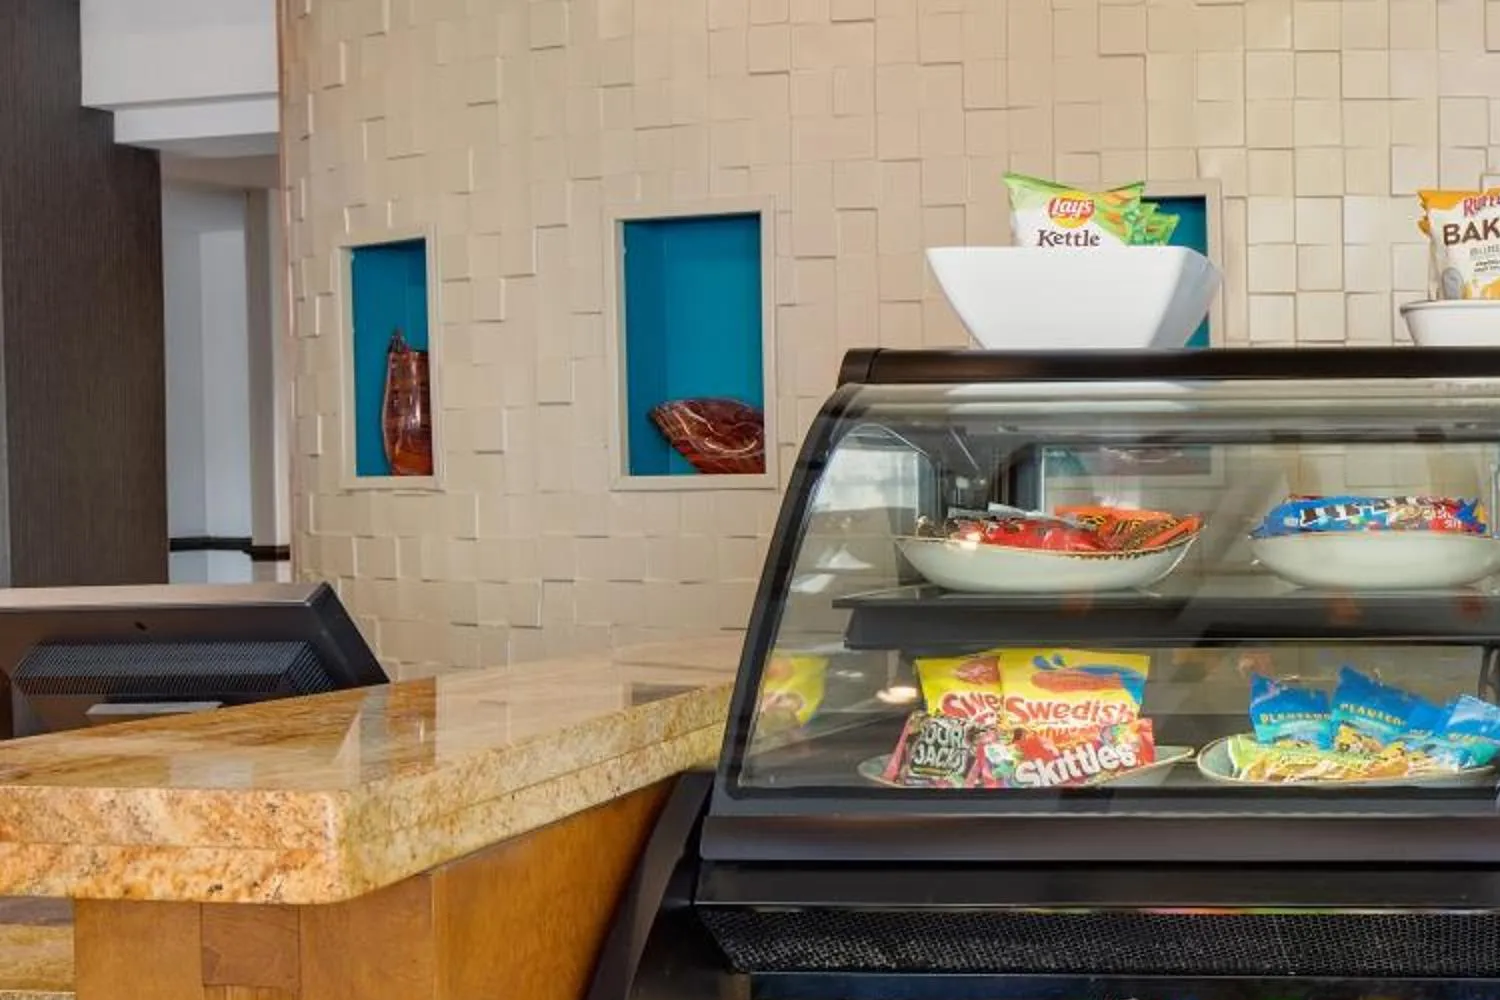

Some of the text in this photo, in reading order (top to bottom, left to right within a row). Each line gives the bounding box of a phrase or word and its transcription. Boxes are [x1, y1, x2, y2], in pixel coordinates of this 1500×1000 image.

[1037, 229, 1101, 247] Kettle
[1005, 695, 1136, 727] Swedish
[1016, 741, 1138, 787] Skittles
